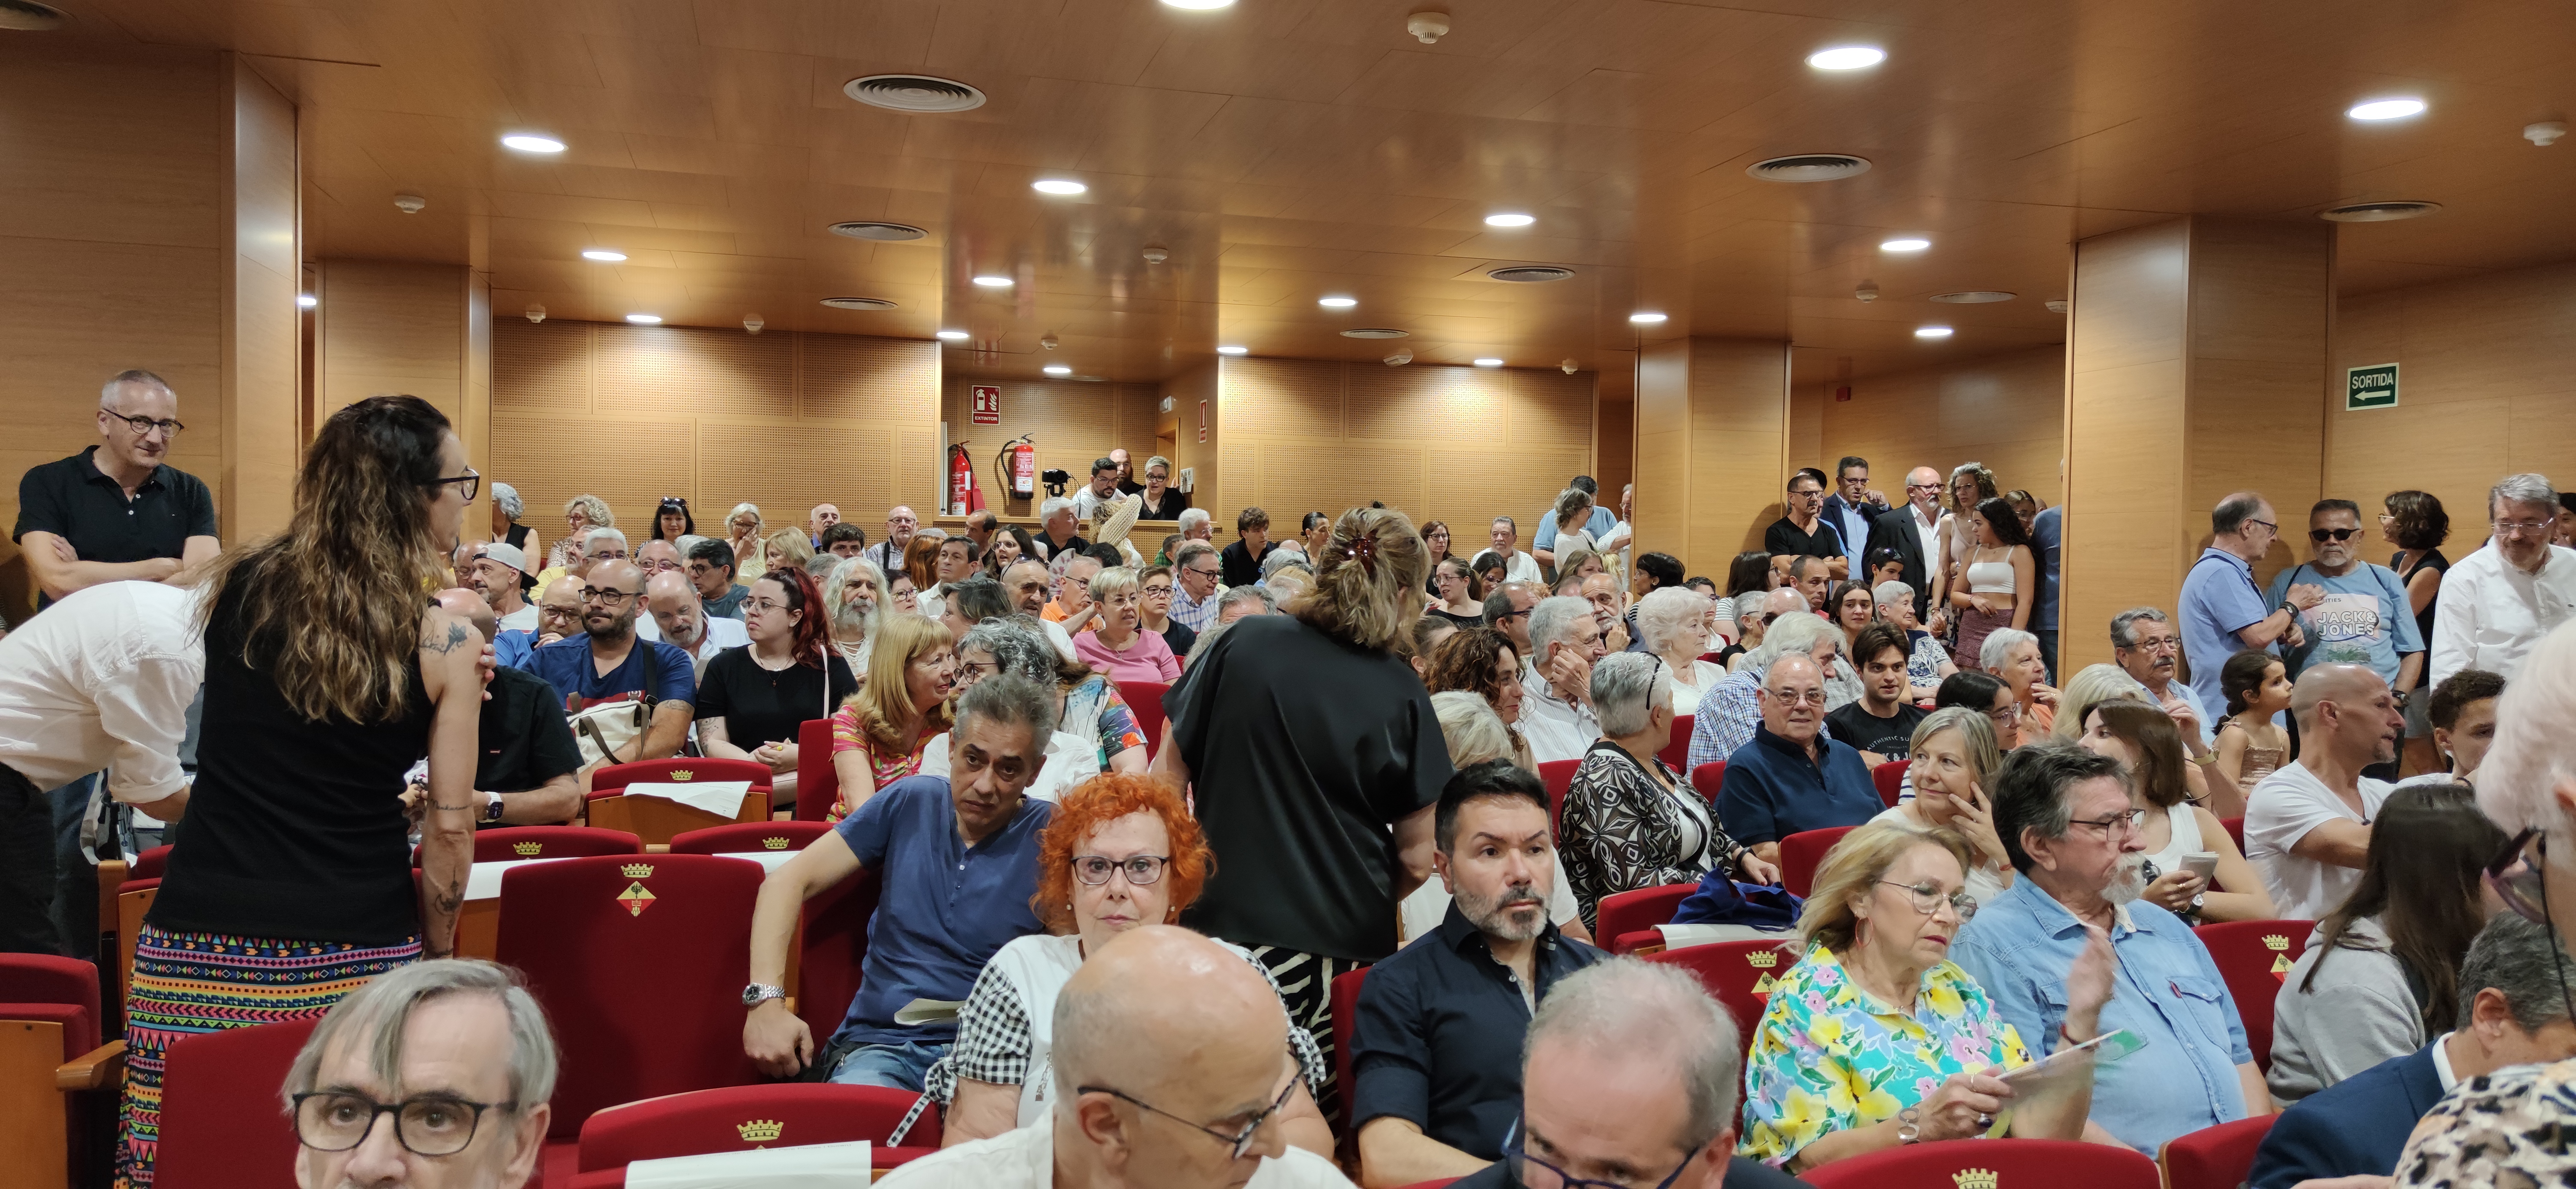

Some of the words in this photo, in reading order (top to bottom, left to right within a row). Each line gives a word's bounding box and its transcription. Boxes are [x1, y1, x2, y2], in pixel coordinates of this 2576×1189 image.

[2352, 372, 2394, 389] SORTIDA
[2317, 623, 2376, 636] JONES
[1867, 735, 1899, 751] AUTHENTIC
